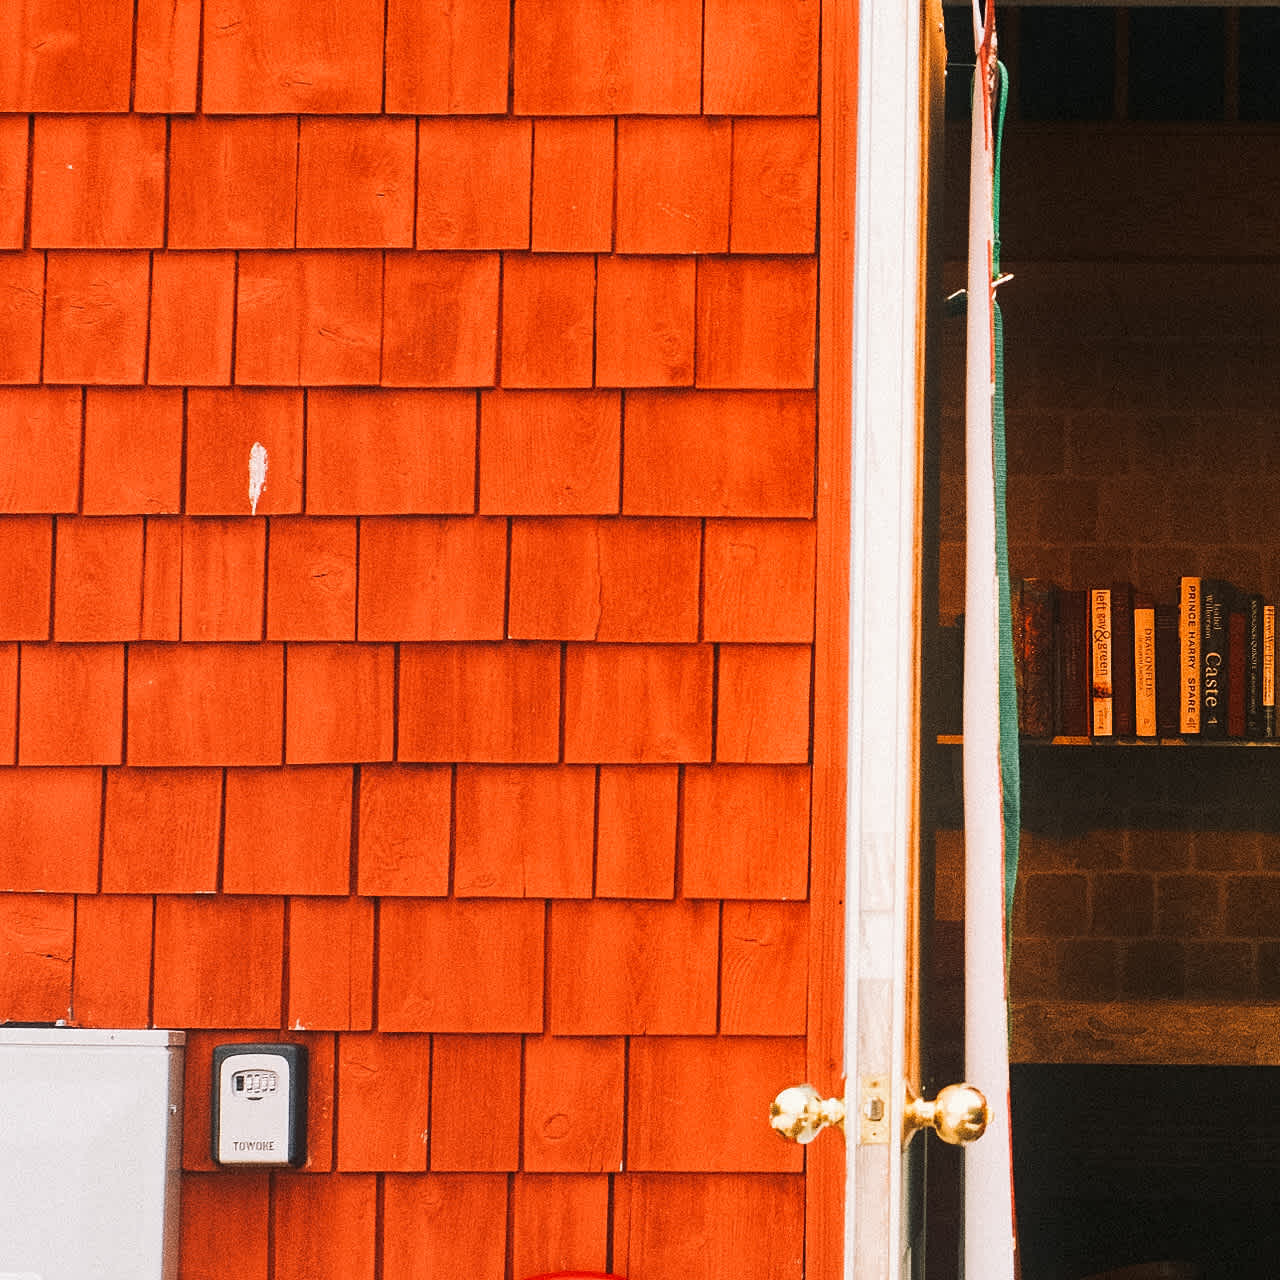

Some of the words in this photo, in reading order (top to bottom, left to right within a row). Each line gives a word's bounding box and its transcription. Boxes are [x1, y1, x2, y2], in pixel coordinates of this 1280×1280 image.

[1096, 591, 1107, 610] left
[1188, 585, 1196, 626] PRINCE
[1188, 631, 1196, 669] HARRY
[1188, 678, 1196, 713] SPARE
[1205, 652, 1222, 707] Caste
